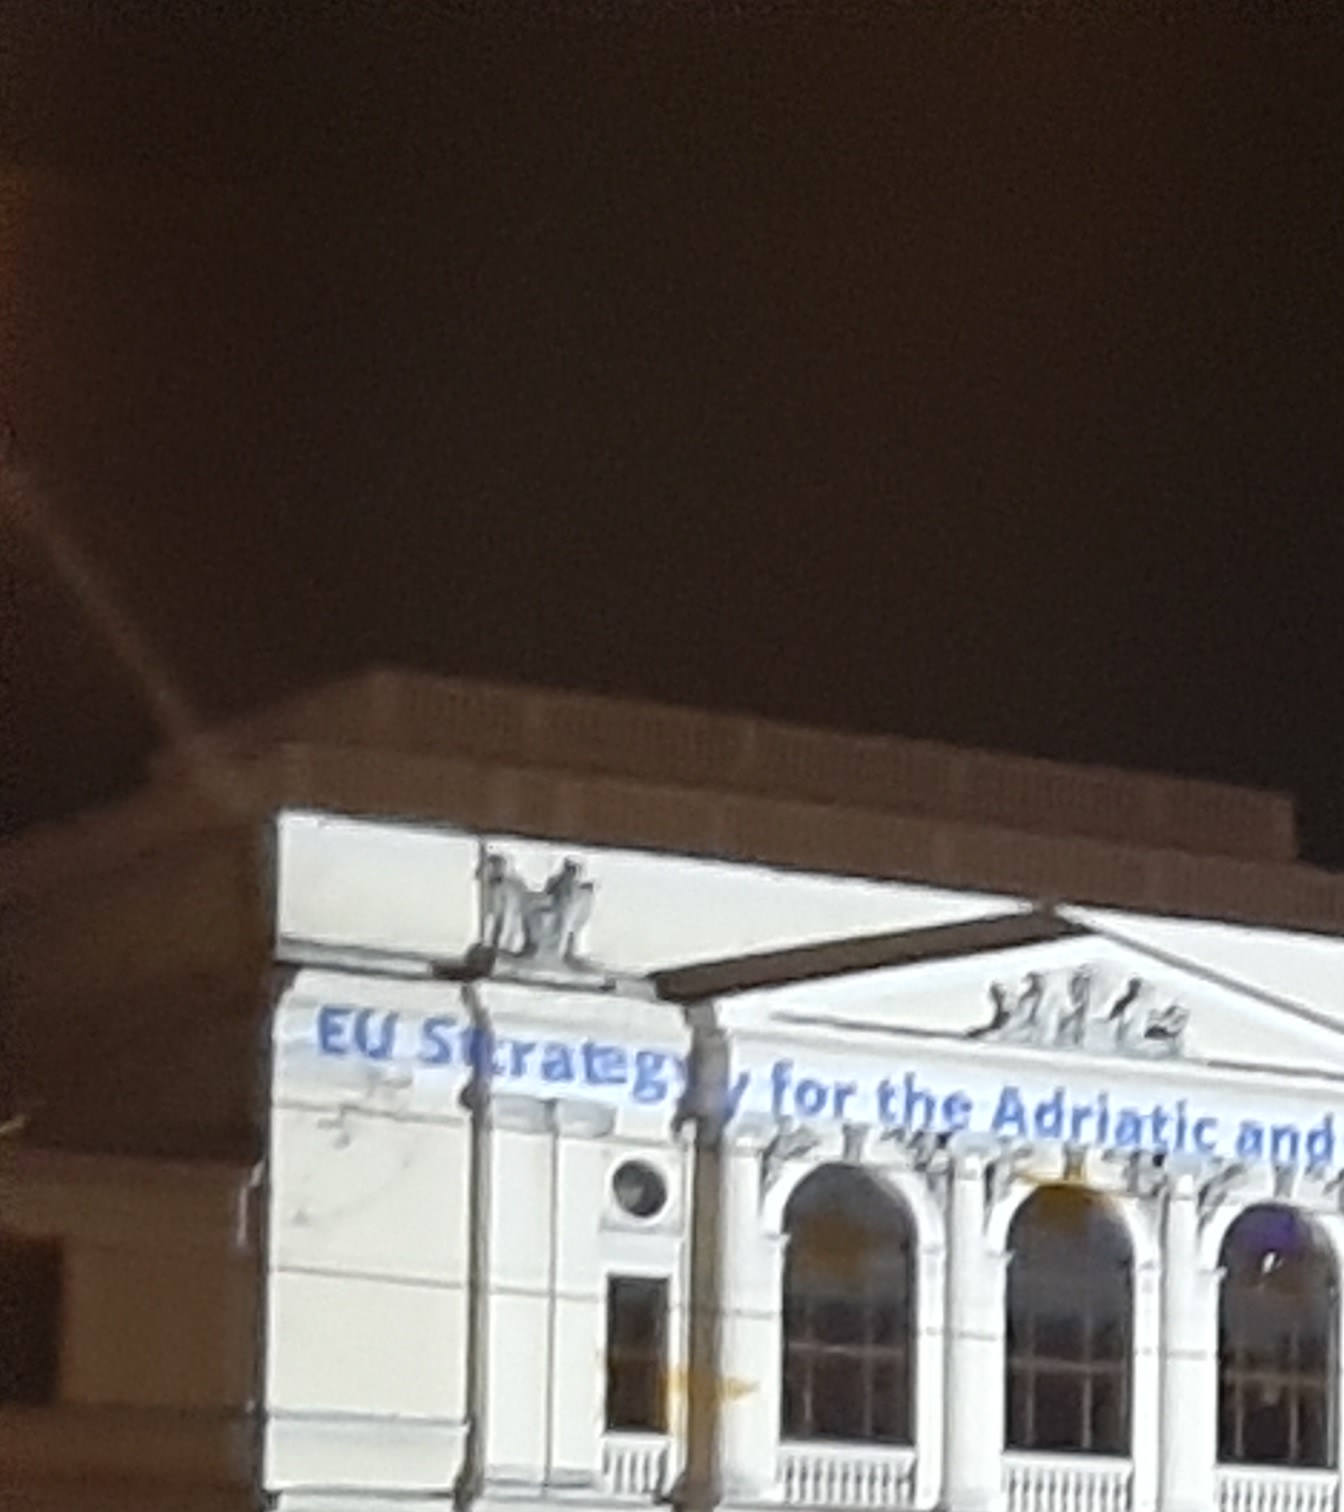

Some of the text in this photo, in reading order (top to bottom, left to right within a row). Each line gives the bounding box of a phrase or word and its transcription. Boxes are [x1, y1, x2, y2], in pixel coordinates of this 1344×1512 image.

[318, 1005, 401, 1061] EU
[772, 1059, 857, 1119] for
[877, 1071, 973, 1131] the
[990, 1084, 1220, 1152] Adriatic
[1235, 1112, 1336, 1163] and
